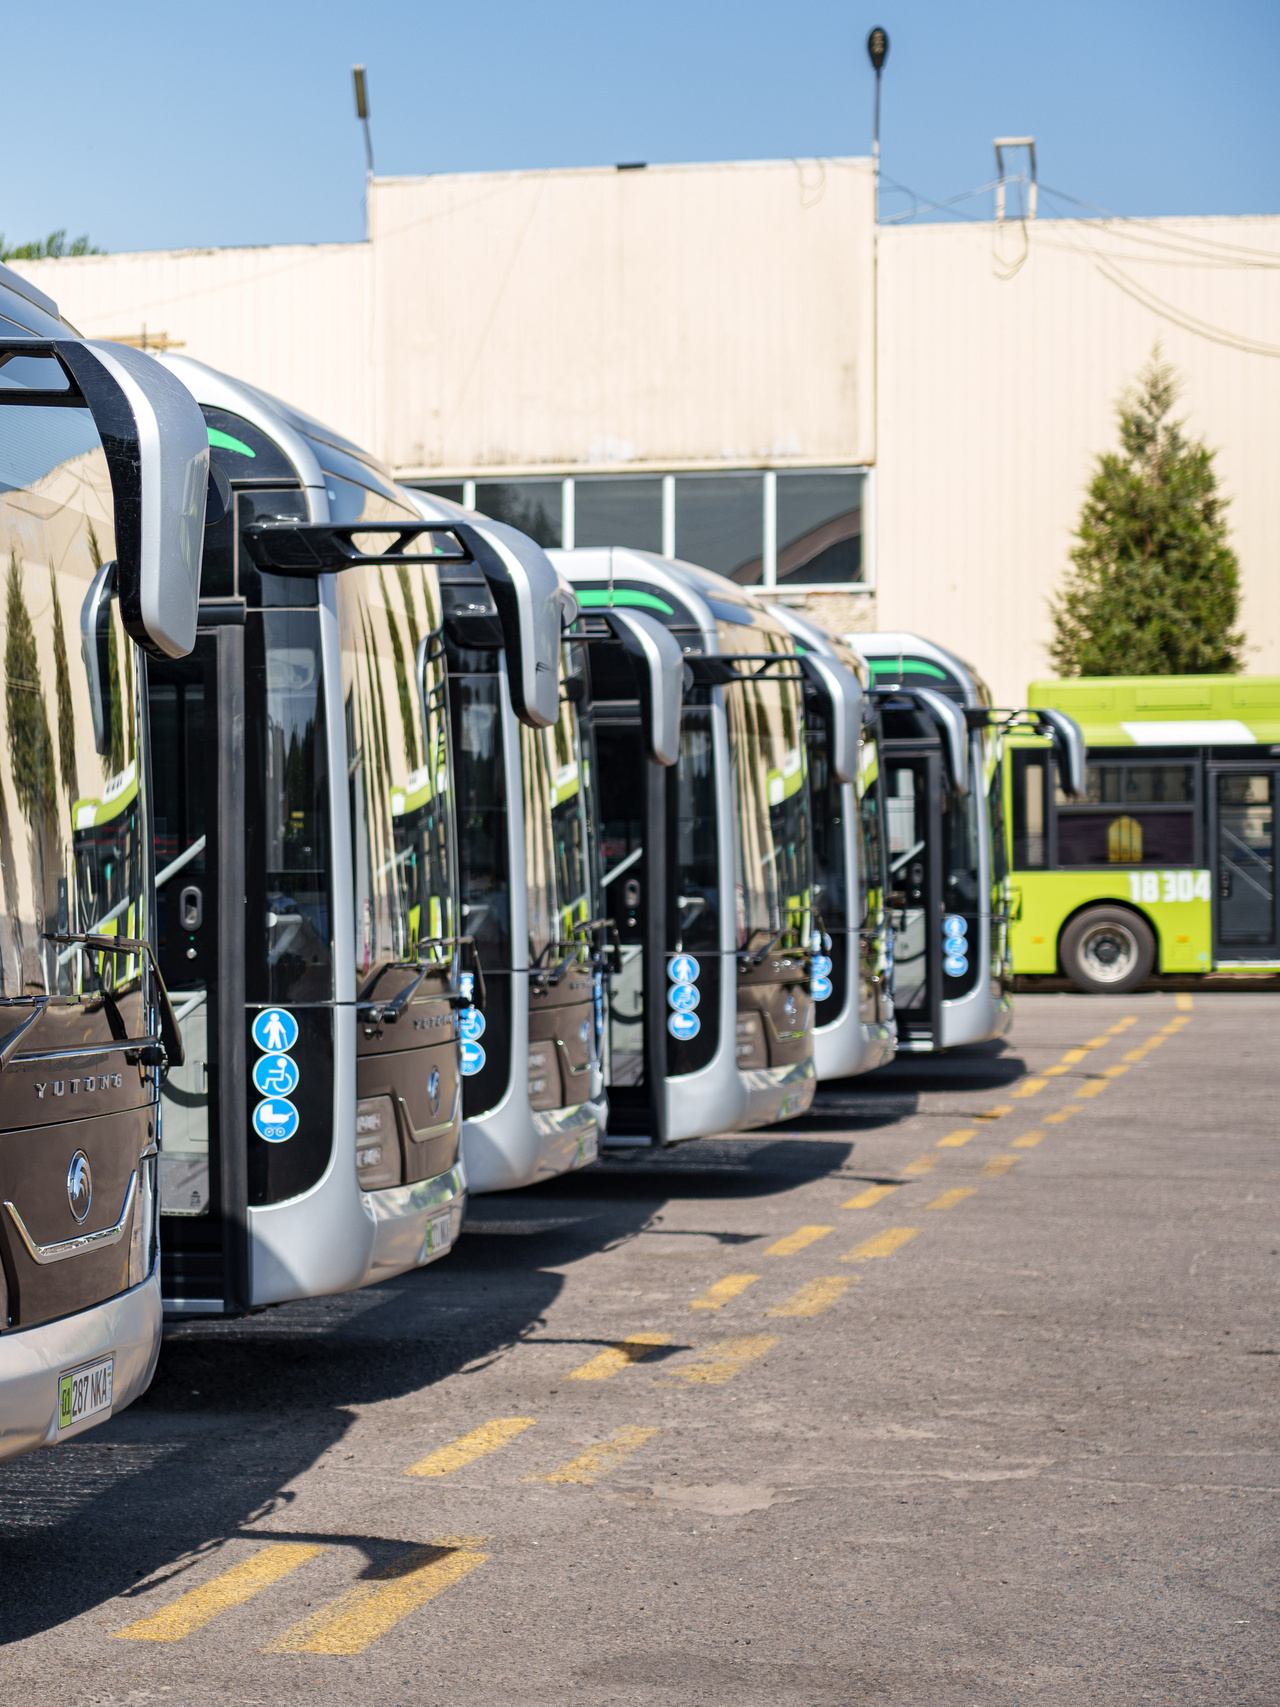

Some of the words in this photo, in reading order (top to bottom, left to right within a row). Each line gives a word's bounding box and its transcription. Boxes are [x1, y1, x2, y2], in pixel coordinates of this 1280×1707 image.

[34, 1074, 122, 1099] YUTONG
[72, 1376, 89, 1417] 287
[90, 1367, 107, 1409] NKA
